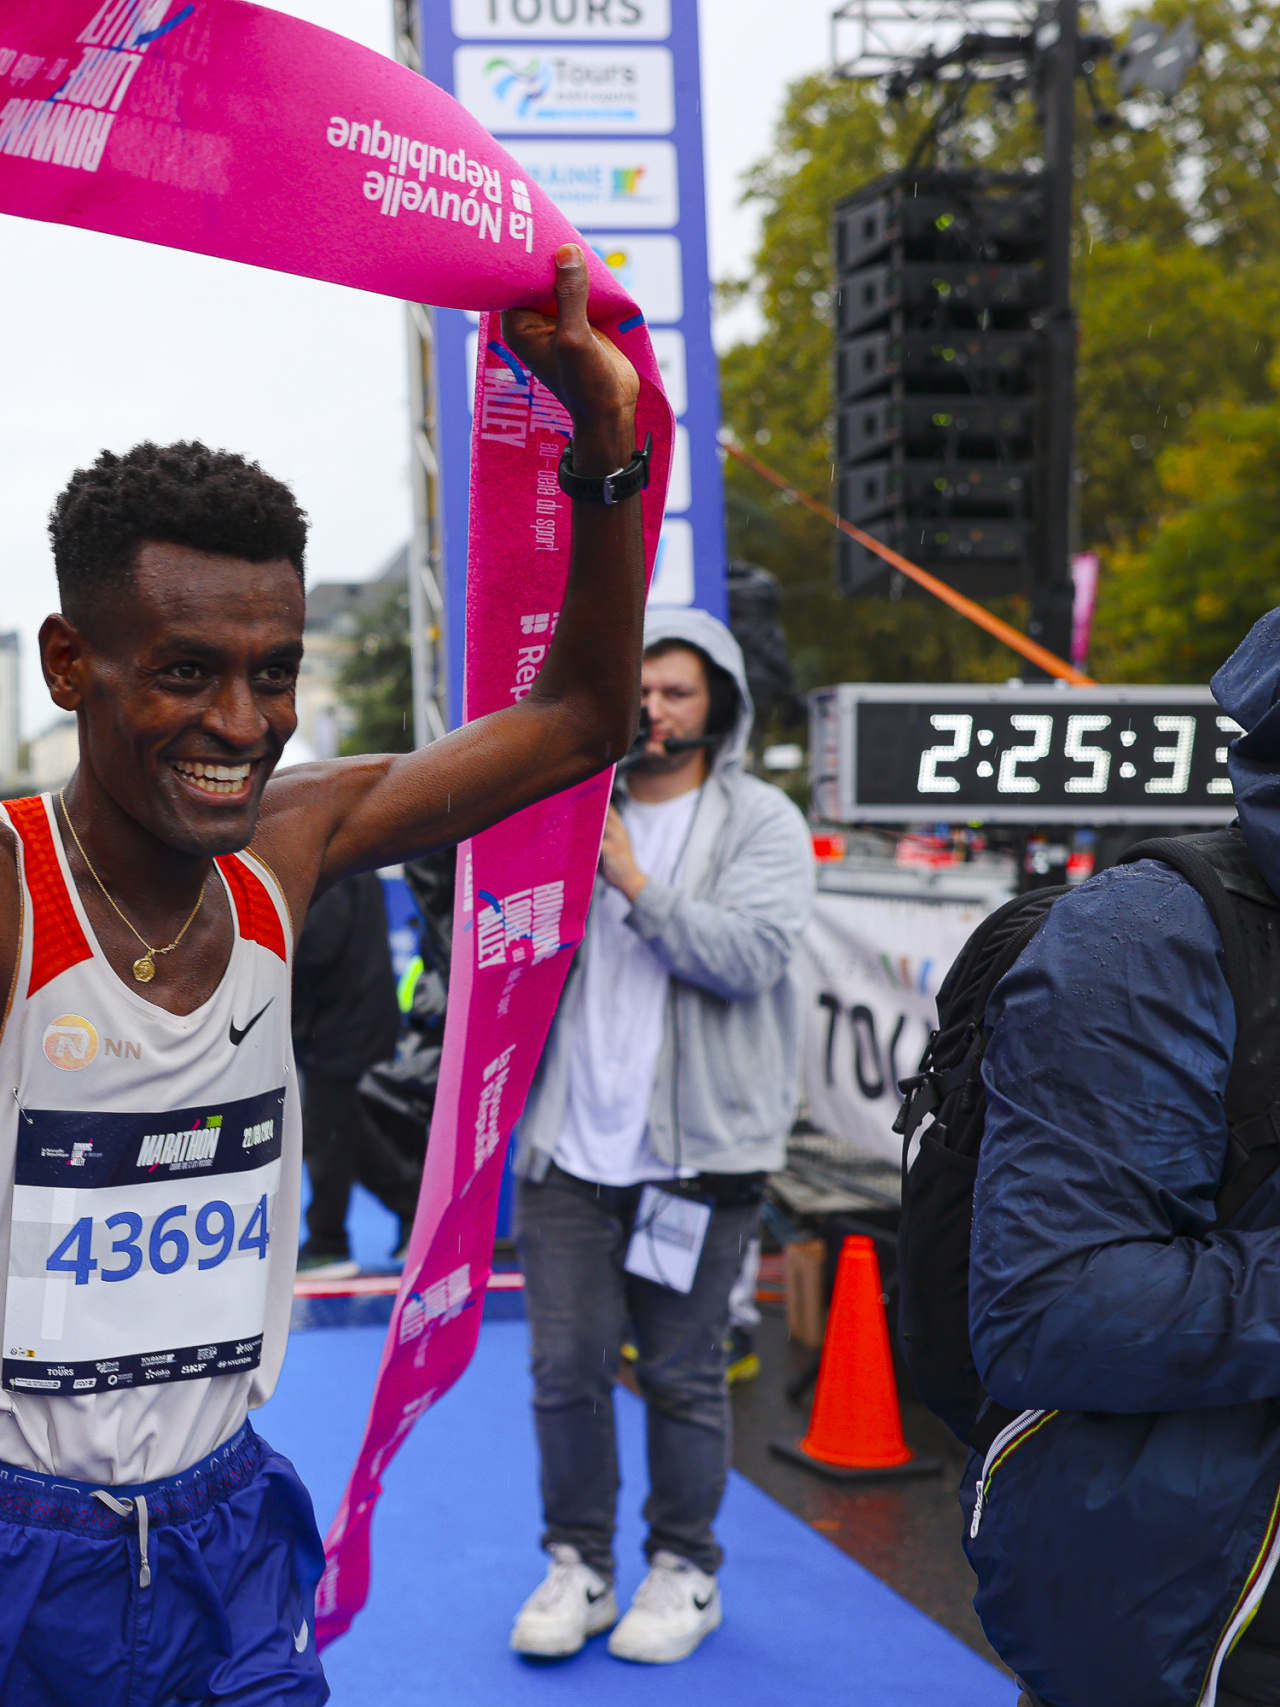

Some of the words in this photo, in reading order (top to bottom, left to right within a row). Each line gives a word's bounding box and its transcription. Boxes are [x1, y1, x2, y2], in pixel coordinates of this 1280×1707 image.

[54, 46, 144, 112] LOIRE
[326, 116, 504, 204] République
[363, 170, 503, 243] Nouvelle
[509, 212, 534, 253] la
[480, 366, 528, 449] VALLEY
[530, 520, 560, 552] sport
[537, 500, 563, 518] du
[477, 899, 507, 970] VALLEY
[503, 887, 533, 948] LOIRE
[103, 1037, 142, 1060] NN
[136, 1127, 221, 1168] MARATHON
[46, 1193, 270, 1285] 43694
[47, 1368, 75, 1376] TOURS
[181, 1363, 207, 1374] SKF
